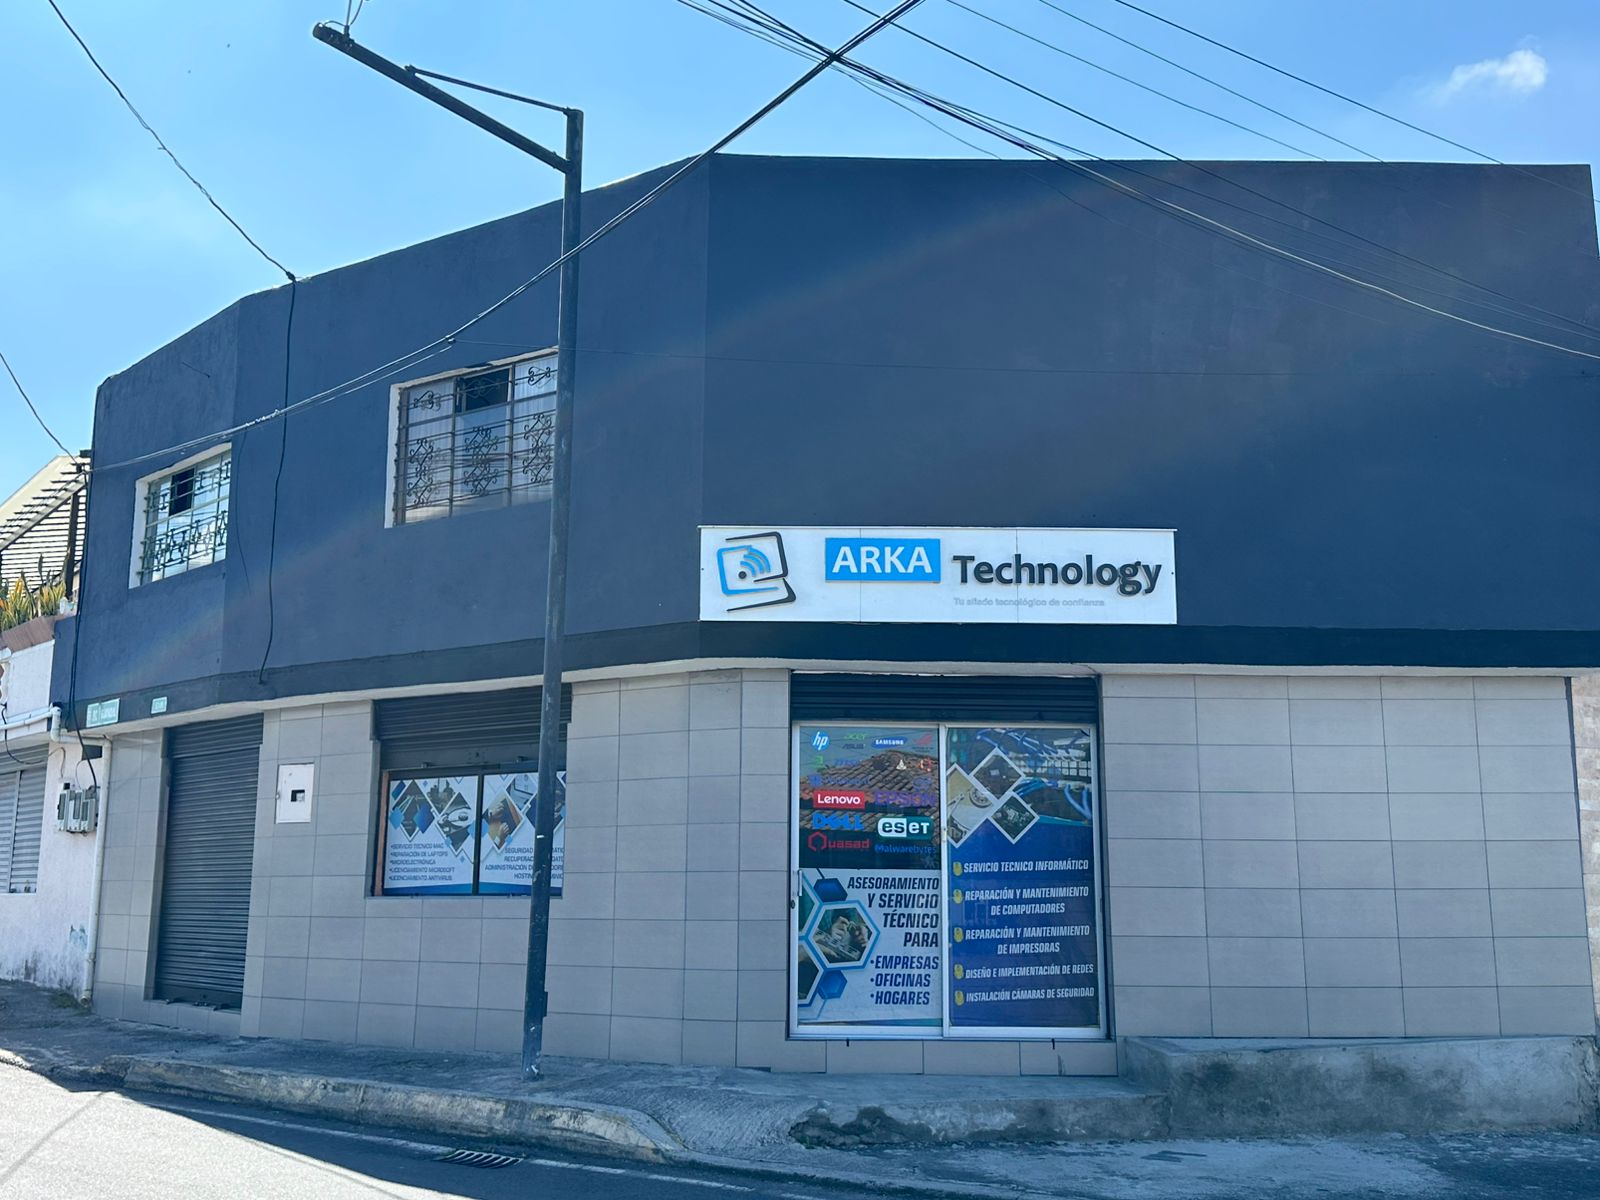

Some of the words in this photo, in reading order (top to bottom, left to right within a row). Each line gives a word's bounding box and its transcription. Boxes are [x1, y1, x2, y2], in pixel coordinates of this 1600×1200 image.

[832, 546, 933, 574] ARKA
[952, 553, 1163, 597] Technology
[954, 598, 965, 606] Tu
[1050, 598, 1060, 606] de
[1062, 597, 1105, 607] confianza
[812, 731, 829, 751] hp
[817, 793, 861, 805] Lenovo
[963, 862, 999, 873] SERVICIO
[1001, 861, 1034, 872] TECNICO
[1035, 858, 1089, 871] INFORMÁTICO
[847, 877, 940, 890] ASESORAMIENTO
[868, 893, 876, 909] Y
[878, 893, 939, 909] SERVICIO
[965, 887, 1015, 901] REPARACIÓN
[1015, 888, 1022, 900] Y
[1022, 886, 1089, 899] MANTENIMIENTO
[990, 905, 1001, 916] DE
[1002, 902, 1066, 915] COMPUTADORES
[883, 909, 939, 929] TÉCNICO
[903, 932, 939, 948] PARA
[965, 926, 1015, 940] REPARACIÓN
[1016, 927, 1022, 938] Y
[1023, 925, 1090, 938] MANTENIMIENTO
[997, 944, 1008, 955] DE
[1009, 942, 1060, 954] IMPRESORAS
[965, 966, 991, 979] DISEÑO
[992, 968, 997, 977] E
[998, 963, 1060, 977] IMPLEMENTACIÓN
[1061, 964, 1071, 975] DE
[1072, 963, 1094, 974] REDES
[966, 989, 1010, 1002] INSTALACIÓN
[1011, 987, 1045, 1000] CÁMARAS
[1046, 988, 1055, 999] DE
[1056, 986, 1095, 998] SEGURIDAD
